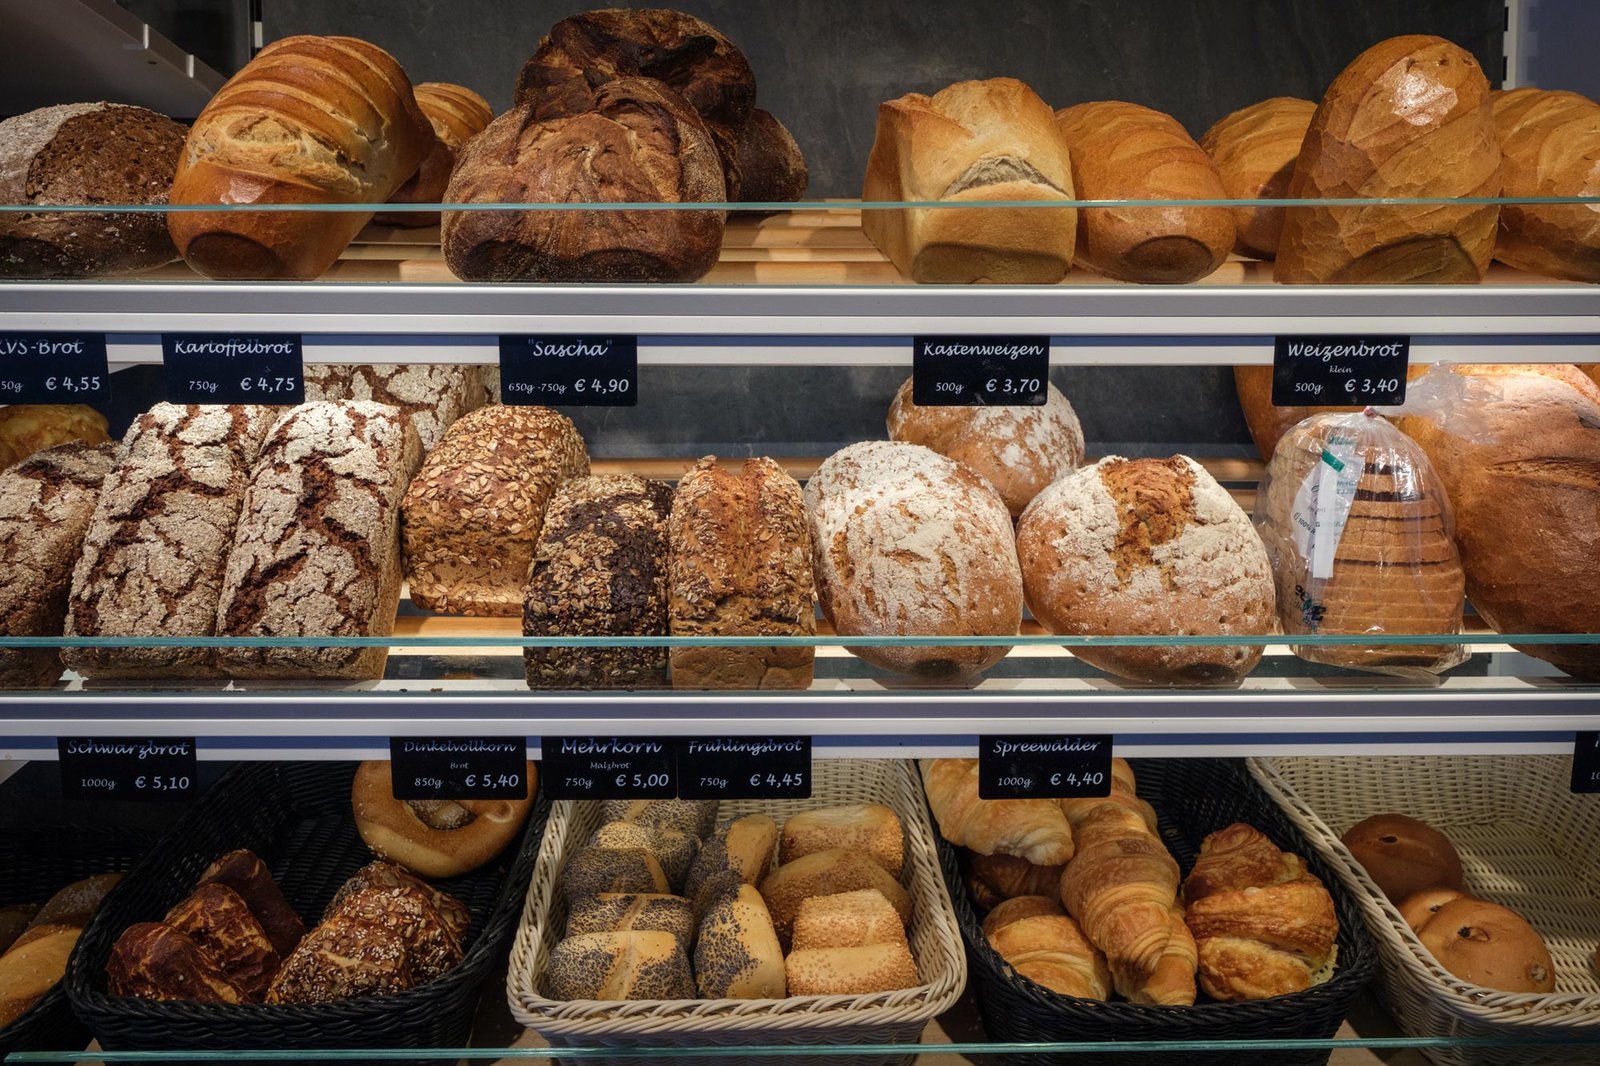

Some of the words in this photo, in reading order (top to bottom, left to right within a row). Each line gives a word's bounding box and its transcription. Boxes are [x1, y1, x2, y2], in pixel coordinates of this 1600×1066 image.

[175, 339, 294, 357] Kartoffelbrot
[528, 339, 612, 357] "Sascha"
[923, 342, 1044, 360] Kastenweizen
[1288, 340, 1403, 362] Weizenbrot
[1329, 365, 1353, 374] klein
[45, 377, 57, 391] €
[62, 376, 101, 392] 4,55
[189, 380, 219, 393] 750g
[240, 377, 252, 391] €
[257, 377, 295, 393] 4,75
[508, 382, 535, 394] 650g
[574, 379, 586, 392] €
[591, 379, 630, 394] 4,90
[935, 382, 965, 394] 500g
[986, 379, 997, 392] €
[1002, 378, 1040, 394] 3,70
[1294, 382, 1324, 394] 500g
[1344, 379, 1356, 392] €
[1361, 378, 1399, 394] 3,40
[67, 740, 190, 760] Schwarzbrot
[404, 740, 517, 752] Dinkelvollkorn
[561, 738, 662, 754] Mehrkorn
[993, 738, 1101, 757] Spreewälder
[81, 779, 117, 790] 1000g
[135, 776, 147, 788] €
[152, 776, 190, 791] 5,10
[414, 777, 443, 789] 850g
[465, 774, 477, 787] €
[482, 774, 519, 789] 5,40
[565, 777, 593, 789] 750g
[616, 774, 627, 787] €
[632, 773, 669, 789] 5,00
[700, 777, 729, 789] 750g
[750, 774, 761, 786] €
[766, 773, 803, 788] 4,45
[998, 777, 1032, 788] 1000g
[1050, 772, 1062, 786] €
[1067, 772, 1104, 787] 4,40
